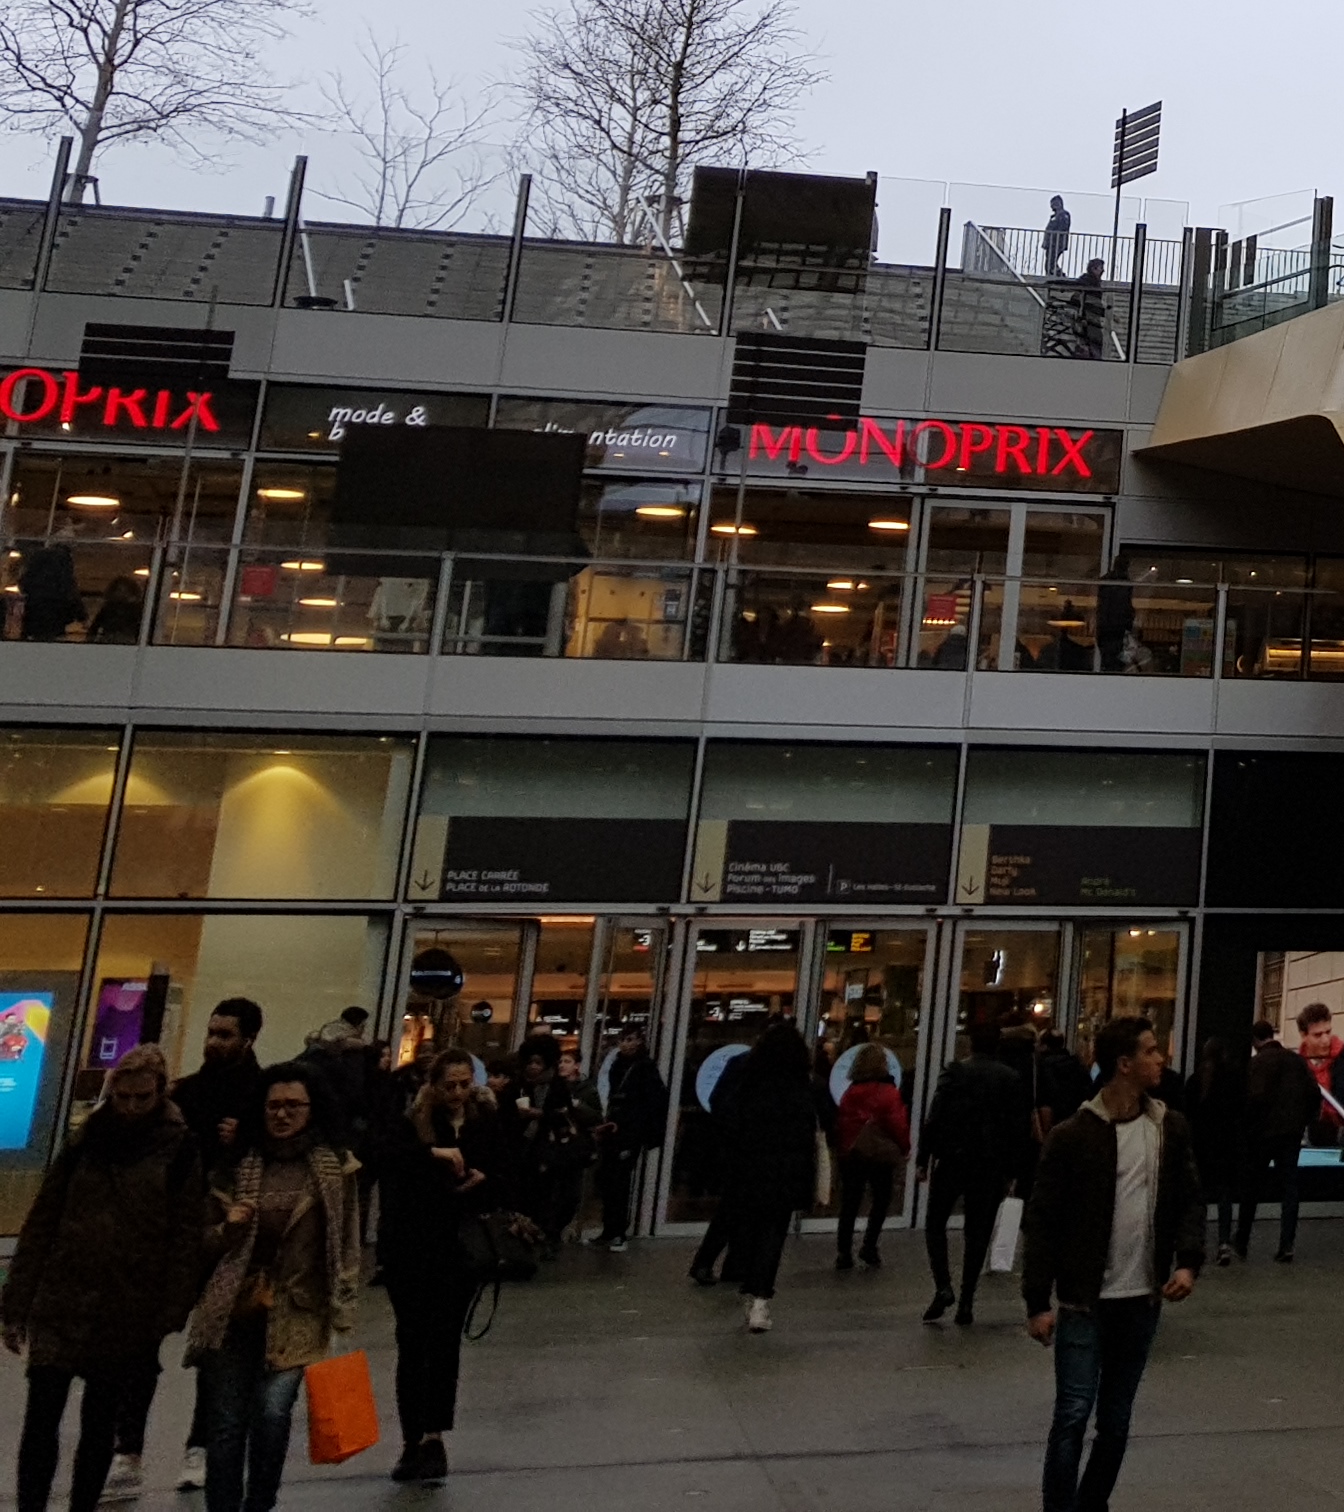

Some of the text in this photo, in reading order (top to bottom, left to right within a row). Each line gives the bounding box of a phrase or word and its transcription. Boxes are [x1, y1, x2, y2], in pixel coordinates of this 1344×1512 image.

[328, 403, 428, 426] mode &
[749, 414, 1094, 478] MONOPRIX
[447, 870, 478, 881] PLACE
[446, 882, 477, 893] PLACE
